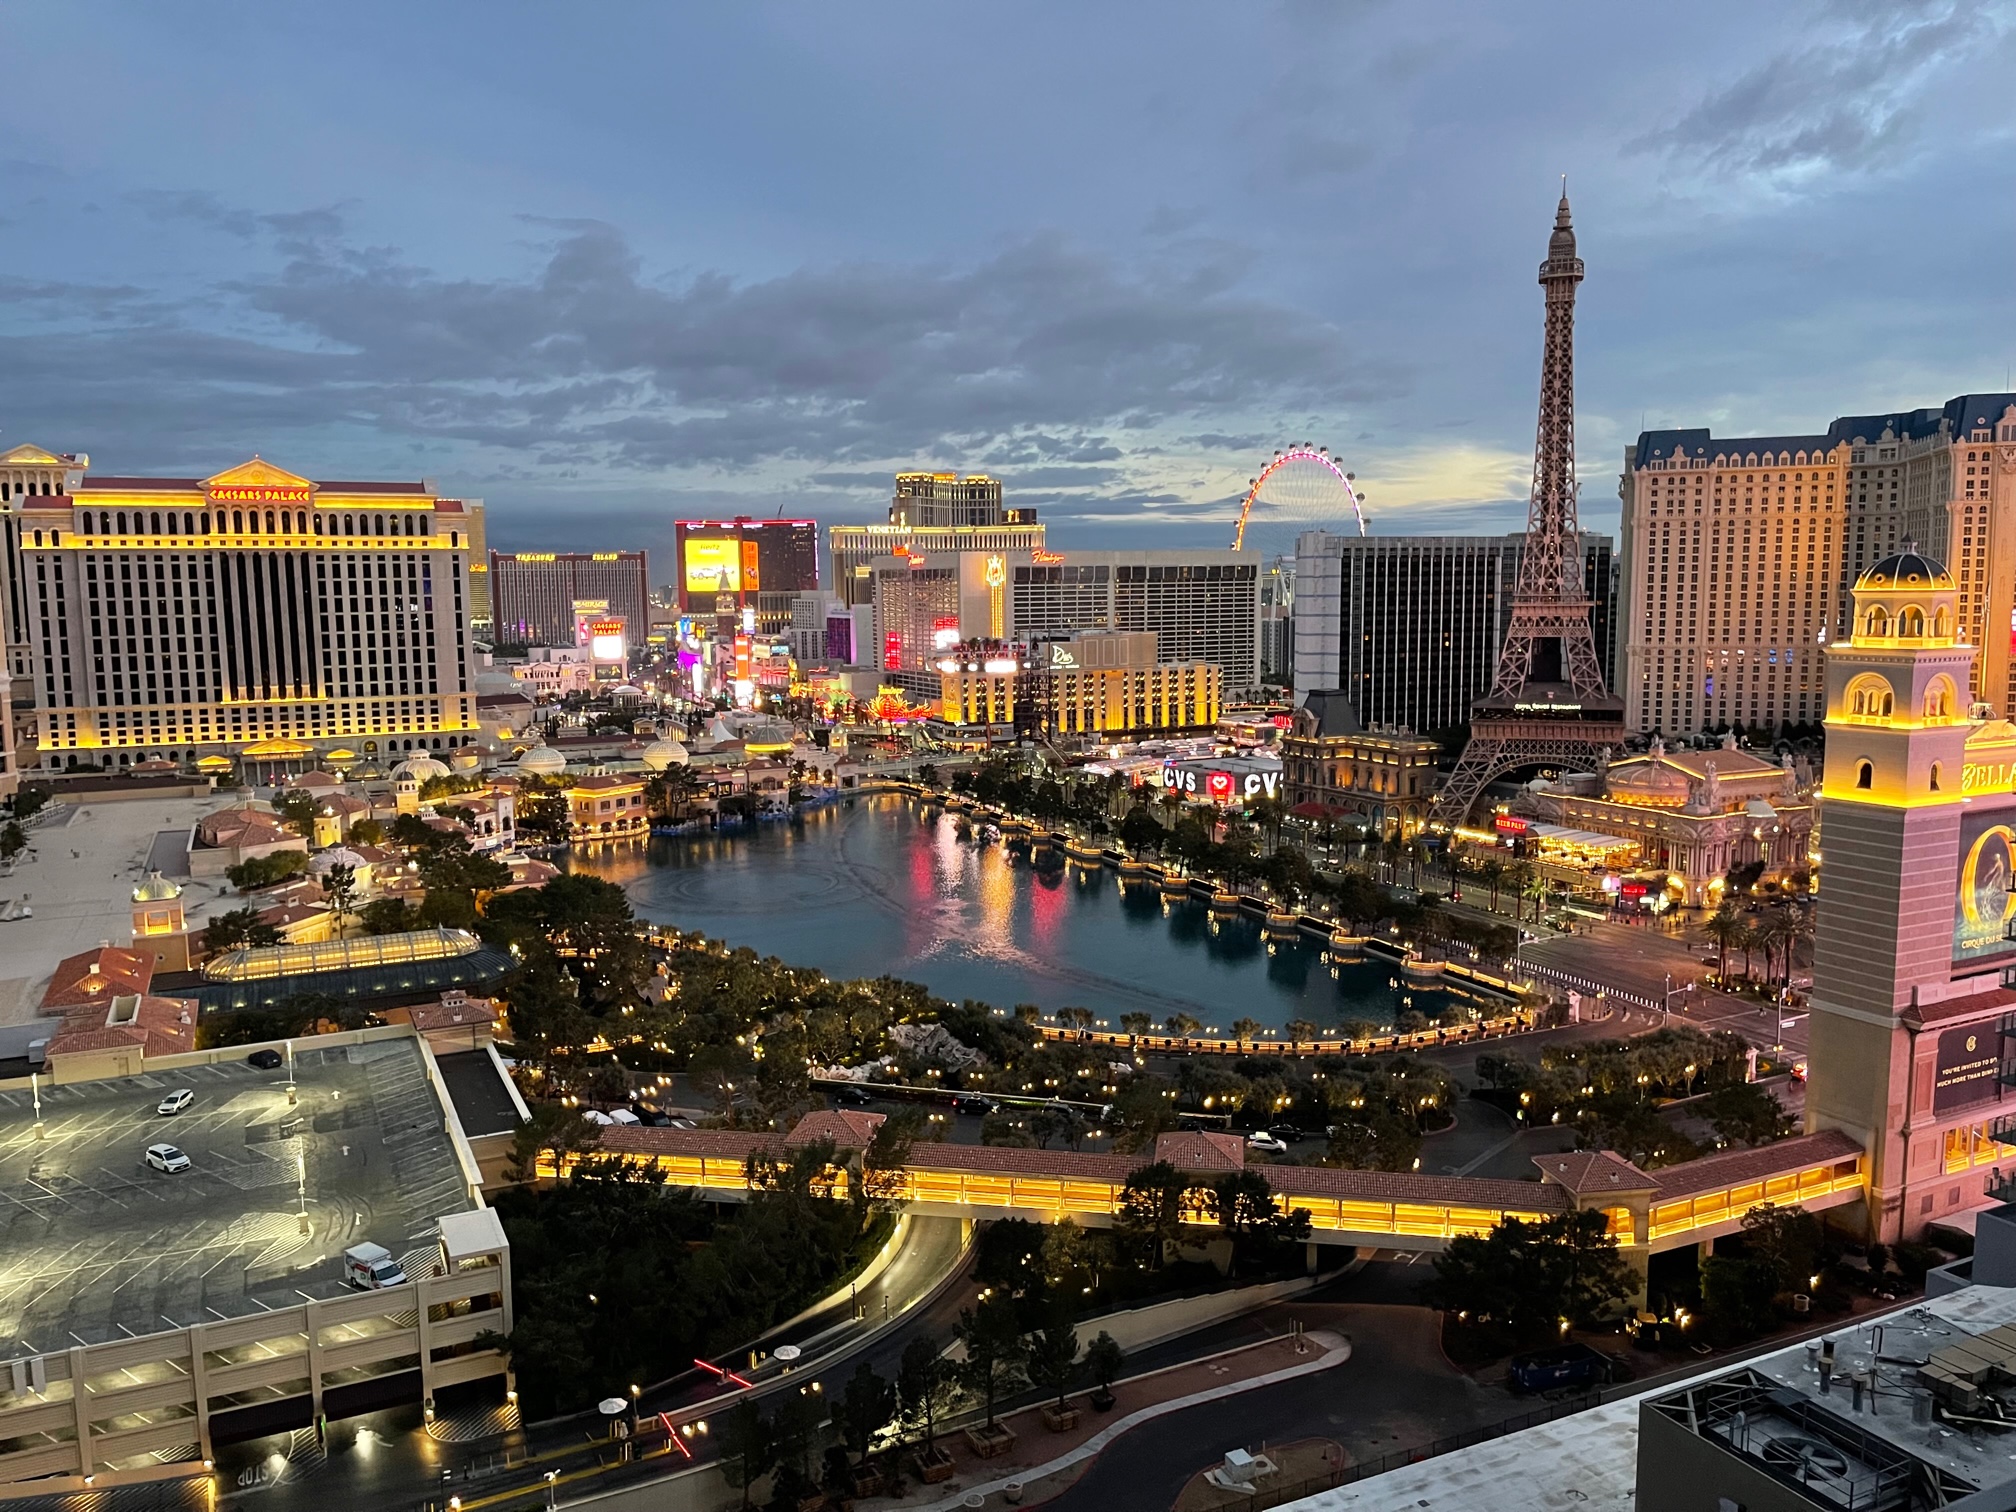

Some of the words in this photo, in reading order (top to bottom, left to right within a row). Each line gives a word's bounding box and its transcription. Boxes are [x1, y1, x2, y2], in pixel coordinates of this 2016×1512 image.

[209, 489, 262, 501] CAESARS
[264, 490, 310, 501] PALACE
[866, 524, 912, 535] VENETIAN
[515, 553, 556, 562] TREASURE
[592, 553, 618, 561] ISLAND
[592, 622, 622, 630] CAESARS
[1164, 768, 1196, 792] CVS
[1244, 772, 1284, 795] CV
[1961, 937, 1985, 950] CIRQUE
[1985, 935, 1996, 945] DU
[1942, 1066, 1961, 1076] YOU'RE
[1960, 1061, 1982, 1071] INVITED
[1937, 1079, 1952, 1088] MUCH
[1951, 1076, 1967, 1085] MORE
[1967, 1072, 1981, 1080] THAN
